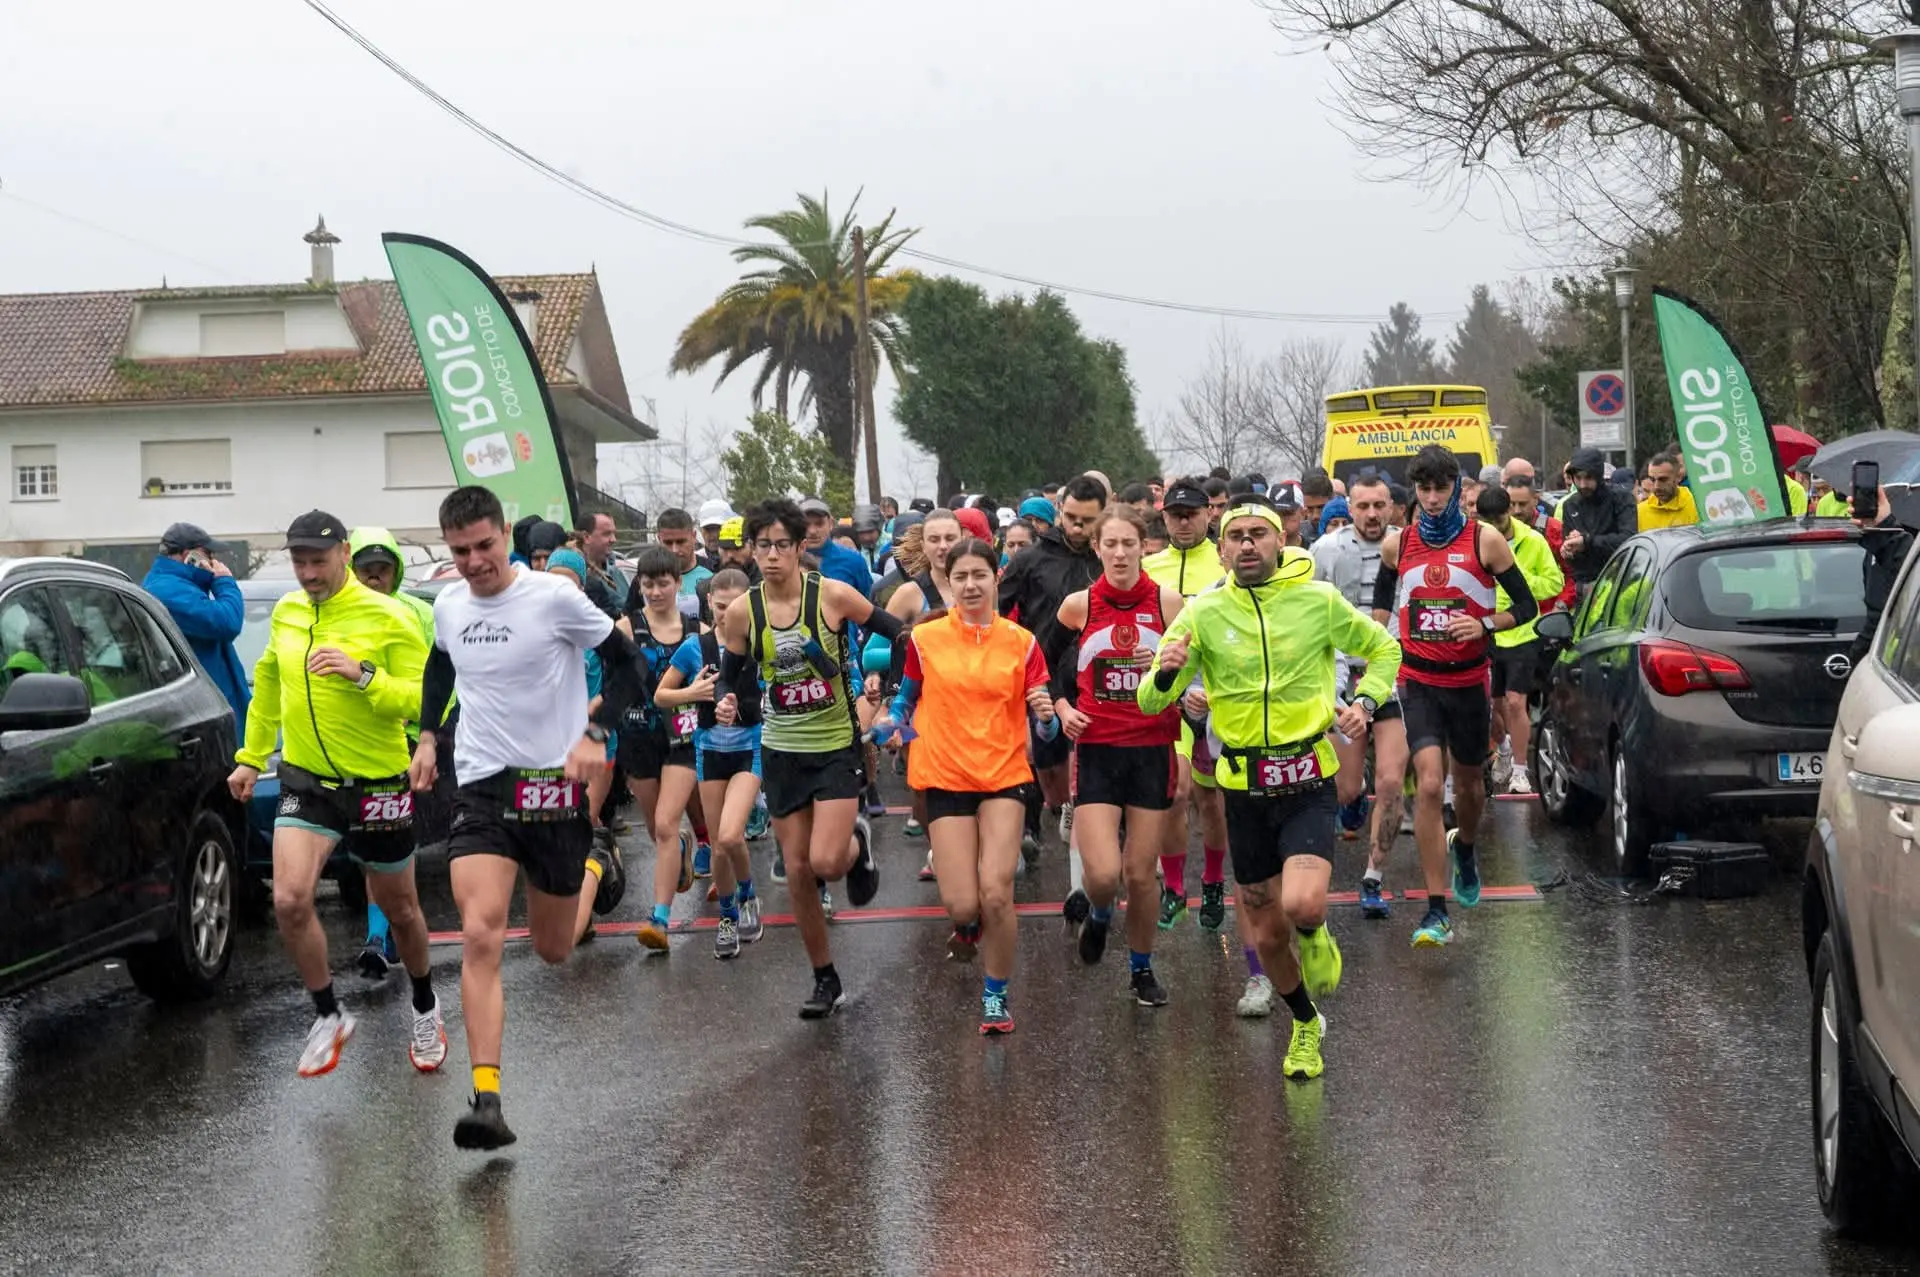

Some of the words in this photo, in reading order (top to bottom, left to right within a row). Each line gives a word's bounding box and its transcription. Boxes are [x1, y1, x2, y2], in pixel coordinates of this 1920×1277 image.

[1356, 428, 1457, 445] AMBULANCIA
[1419, 613, 1453, 631] 29
[782, 680, 827, 706] 276
[1263, 759, 1316, 786] 312
[364, 796, 412, 821] 262
[522, 783, 573, 809] 321
